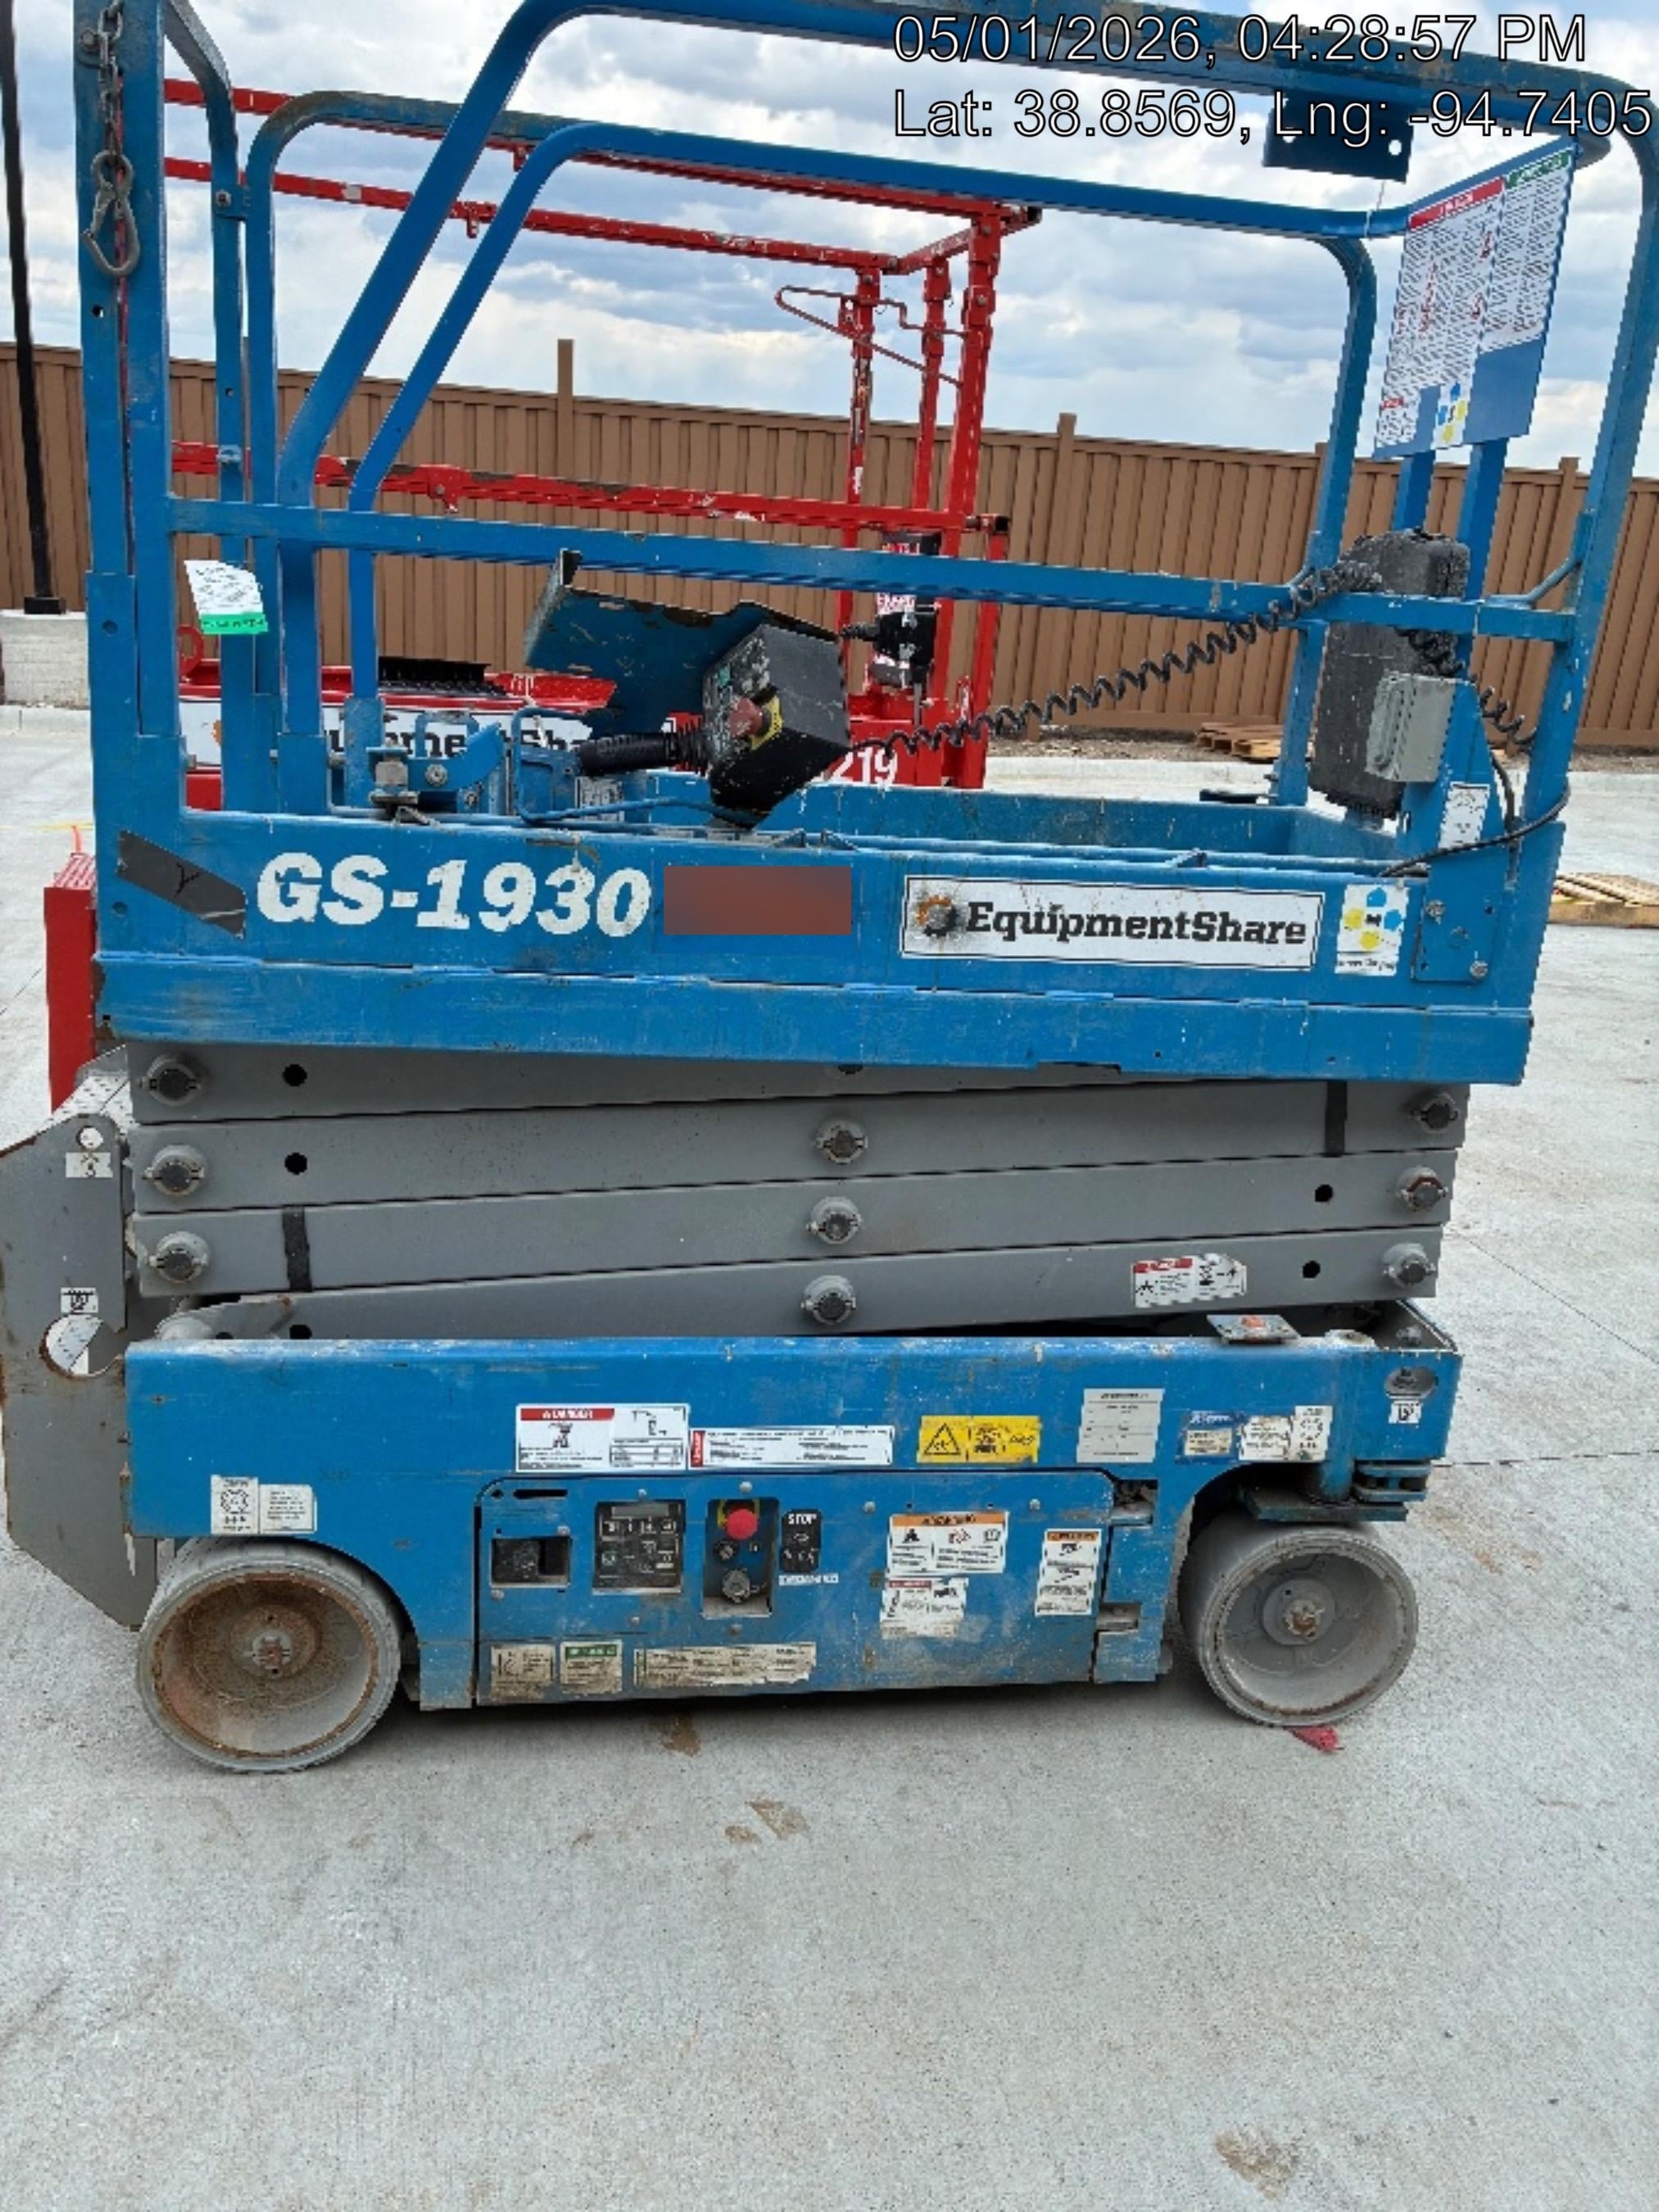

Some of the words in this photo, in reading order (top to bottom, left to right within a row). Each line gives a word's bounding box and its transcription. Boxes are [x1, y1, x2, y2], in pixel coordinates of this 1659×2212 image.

[257, 852, 651, 937] GS-1930
[966, 902, 1306, 944] EquipmentShare
[788, 1513, 817, 1525] STOP
